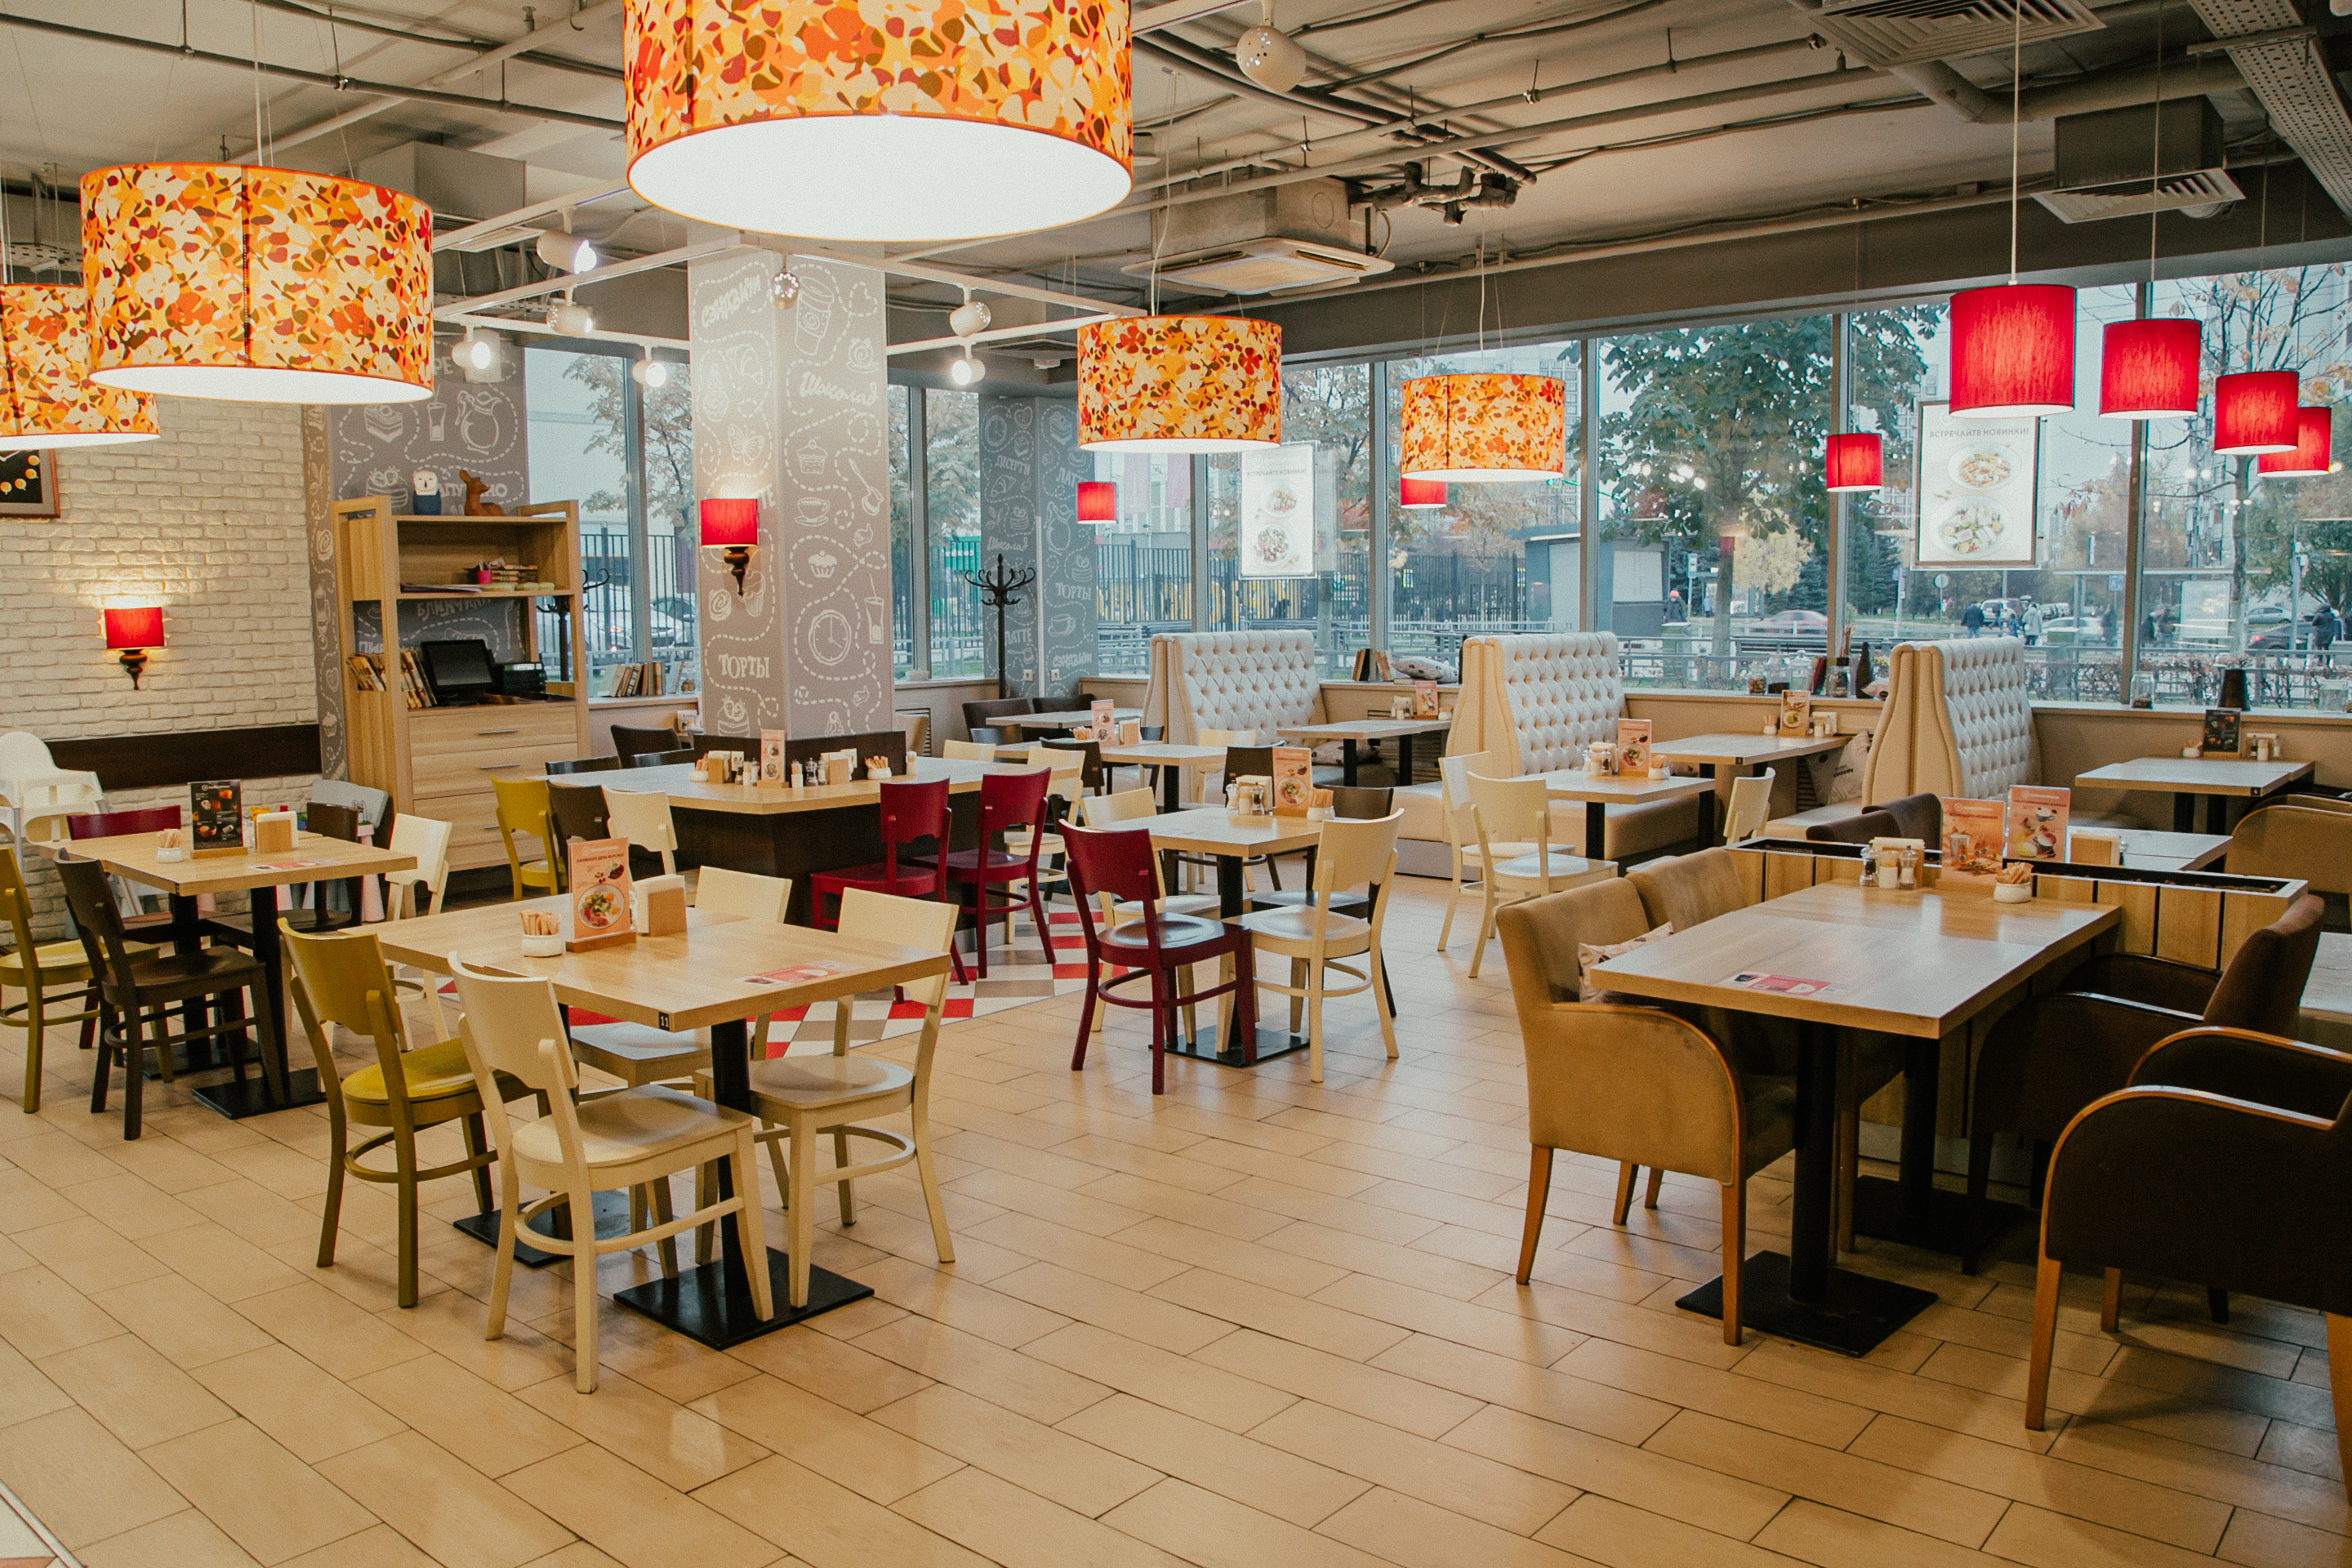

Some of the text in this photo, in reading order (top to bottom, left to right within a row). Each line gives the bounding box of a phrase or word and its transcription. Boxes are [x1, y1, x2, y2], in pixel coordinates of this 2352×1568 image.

[1929, 428, 2029, 438] ВСТРЕЧАЙТЕ НОВИНКИ!
[1055, 466, 1089, 488] ЛАТ
[1055, 582, 1092, 600] ТОРТЫ
[1004, 628, 1032, 646] ЛАТТЕ
[719, 654, 770, 679] ТОРТЫ
[660, 1016, 669, 1027] 11
